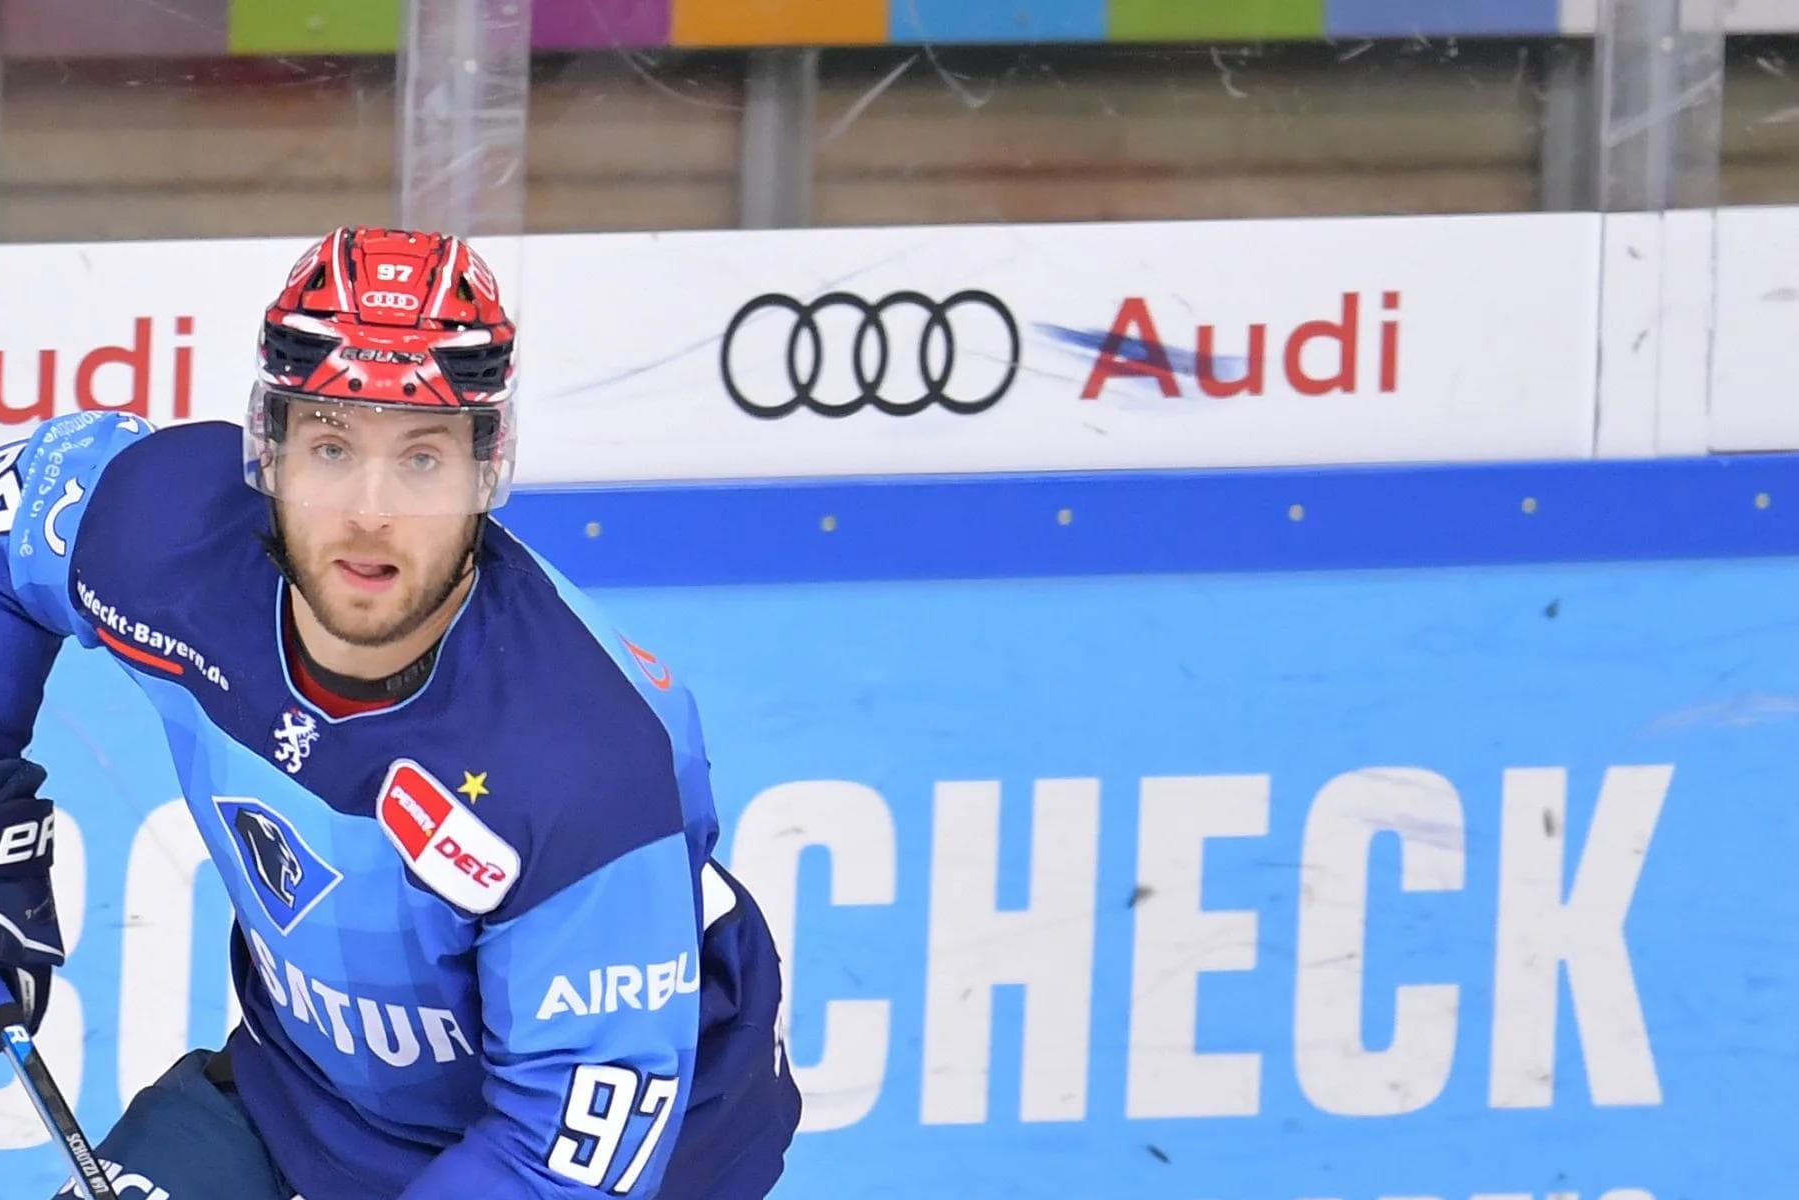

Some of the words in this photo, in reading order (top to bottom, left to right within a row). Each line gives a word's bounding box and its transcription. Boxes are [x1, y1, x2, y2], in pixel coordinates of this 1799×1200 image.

[375, 263, 414, 284] 97
[1080, 291, 1403, 401] Audi
[433, 836, 506, 889] DEL
[547, 1064, 680, 1194] 97
